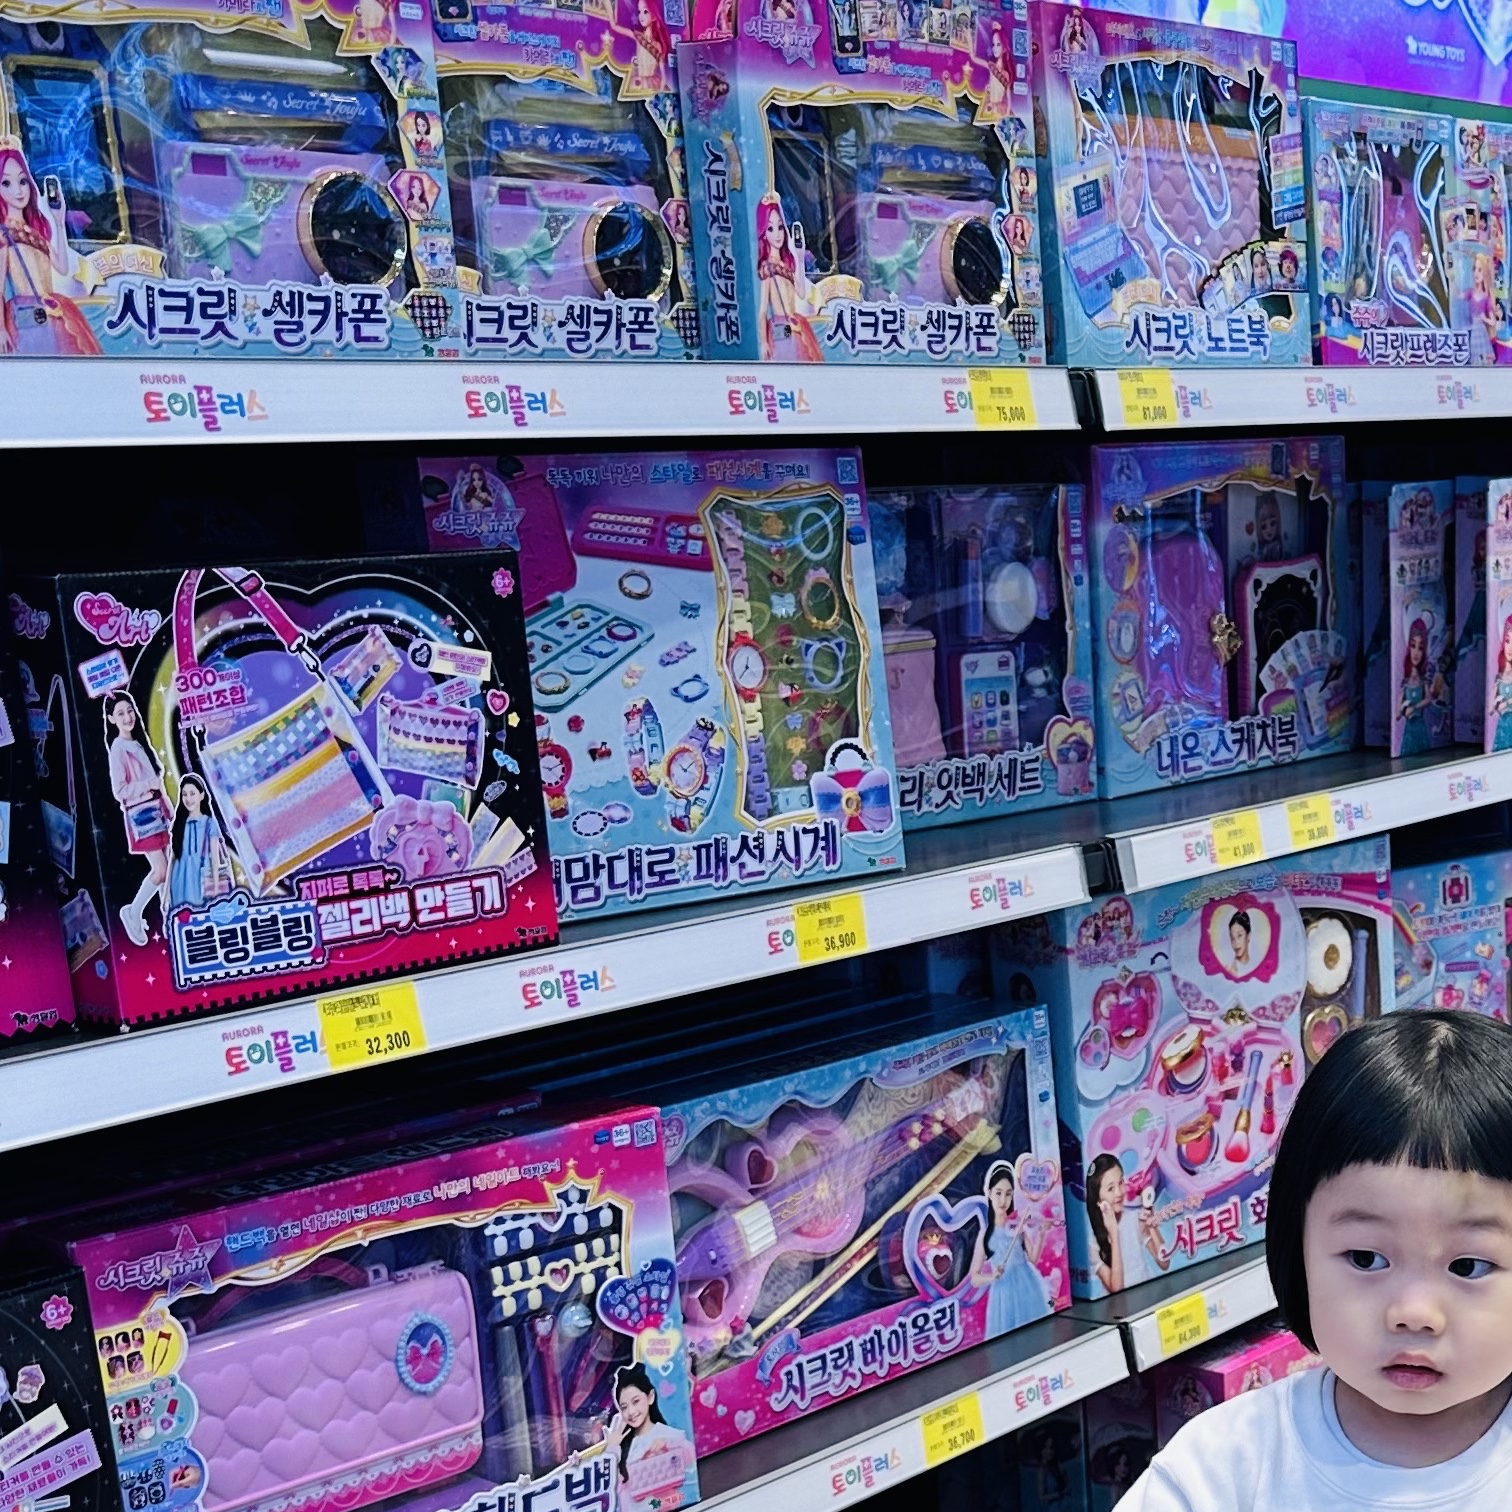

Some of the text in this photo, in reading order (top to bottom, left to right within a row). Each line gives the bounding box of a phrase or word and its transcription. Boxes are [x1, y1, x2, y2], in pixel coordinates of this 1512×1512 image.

[1418, 41, 1466, 63] YOUNG TOYS
[704, 139, 741, 344] 시크릿 셀카폰
[106, 284, 387, 348] 시크릿 셀카폰
[557, 303, 658, 356] 셀카폰
[826, 307, 999, 356] 시크릿 셀카폰
[1125, 310, 1271, 358] 시크릿 노트북
[140, 373, 187, 386] AURORA
[462, 375, 501, 385] AURORA
[1305, 382, 1357, 414] 토이플러스
[1436, 380, 1483, 410] 토이플러스
[143, 385, 270, 432] 토이플러스
[464, 384, 567, 428] 토이플러스
[728, 384, 812, 424] 토이플러스
[996, 405, 1027, 422] 75,000
[574, 462, 811, 485] 끼워 나만의 스타일로 패션시계를 꾸며요!
[432, 509, 484, 536] 시크릿
[495, 575, 511, 587] 6+
[98, 609, 150, 642] Art
[179, 685, 248, 717] 패턴조합
[1156, 713, 1299, 779] 네온 스케치북
[935, 754, 1043, 809] 잇백 세트
[1448, 774, 1491, 803] 토이플러스
[692, 822, 840, 885] 패션시계
[300, 874, 351, 901] 지피로
[969, 875, 1036, 912] 토이플러스
[319, 876, 505, 942] 젤리백 만들기
[183, 913, 316, 966] 블링블링
[824, 931, 858, 952] 36,900
[518, 963, 556, 979] AURORA
[521, 965, 618, 1010] 토이플러스
[221, 1025, 265, 1043] AURORA
[365, 1028, 412, 1056] 32,300
[224, 1227, 278, 1252] 핸드백을
[302, 1208, 353, 1233] 네일샵이
[369, 1199, 401, 1217] 다양한
[402, 1192, 434, 1209] 재료로
[434, 1179, 471, 1202] 나만의
[472, 1168, 521, 1193] 네일아트
[1161, 1200, 1246, 1258] 시크릿
[99, 1257, 167, 1290] 시크릿
[45, 1303, 67, 1321] 6+
[772, 1300, 961, 1407] 시크릿 바이올린
[1013, 1370, 1076, 1413] 토이플러스
[830, 1448, 903, 1498] 토이플러스
